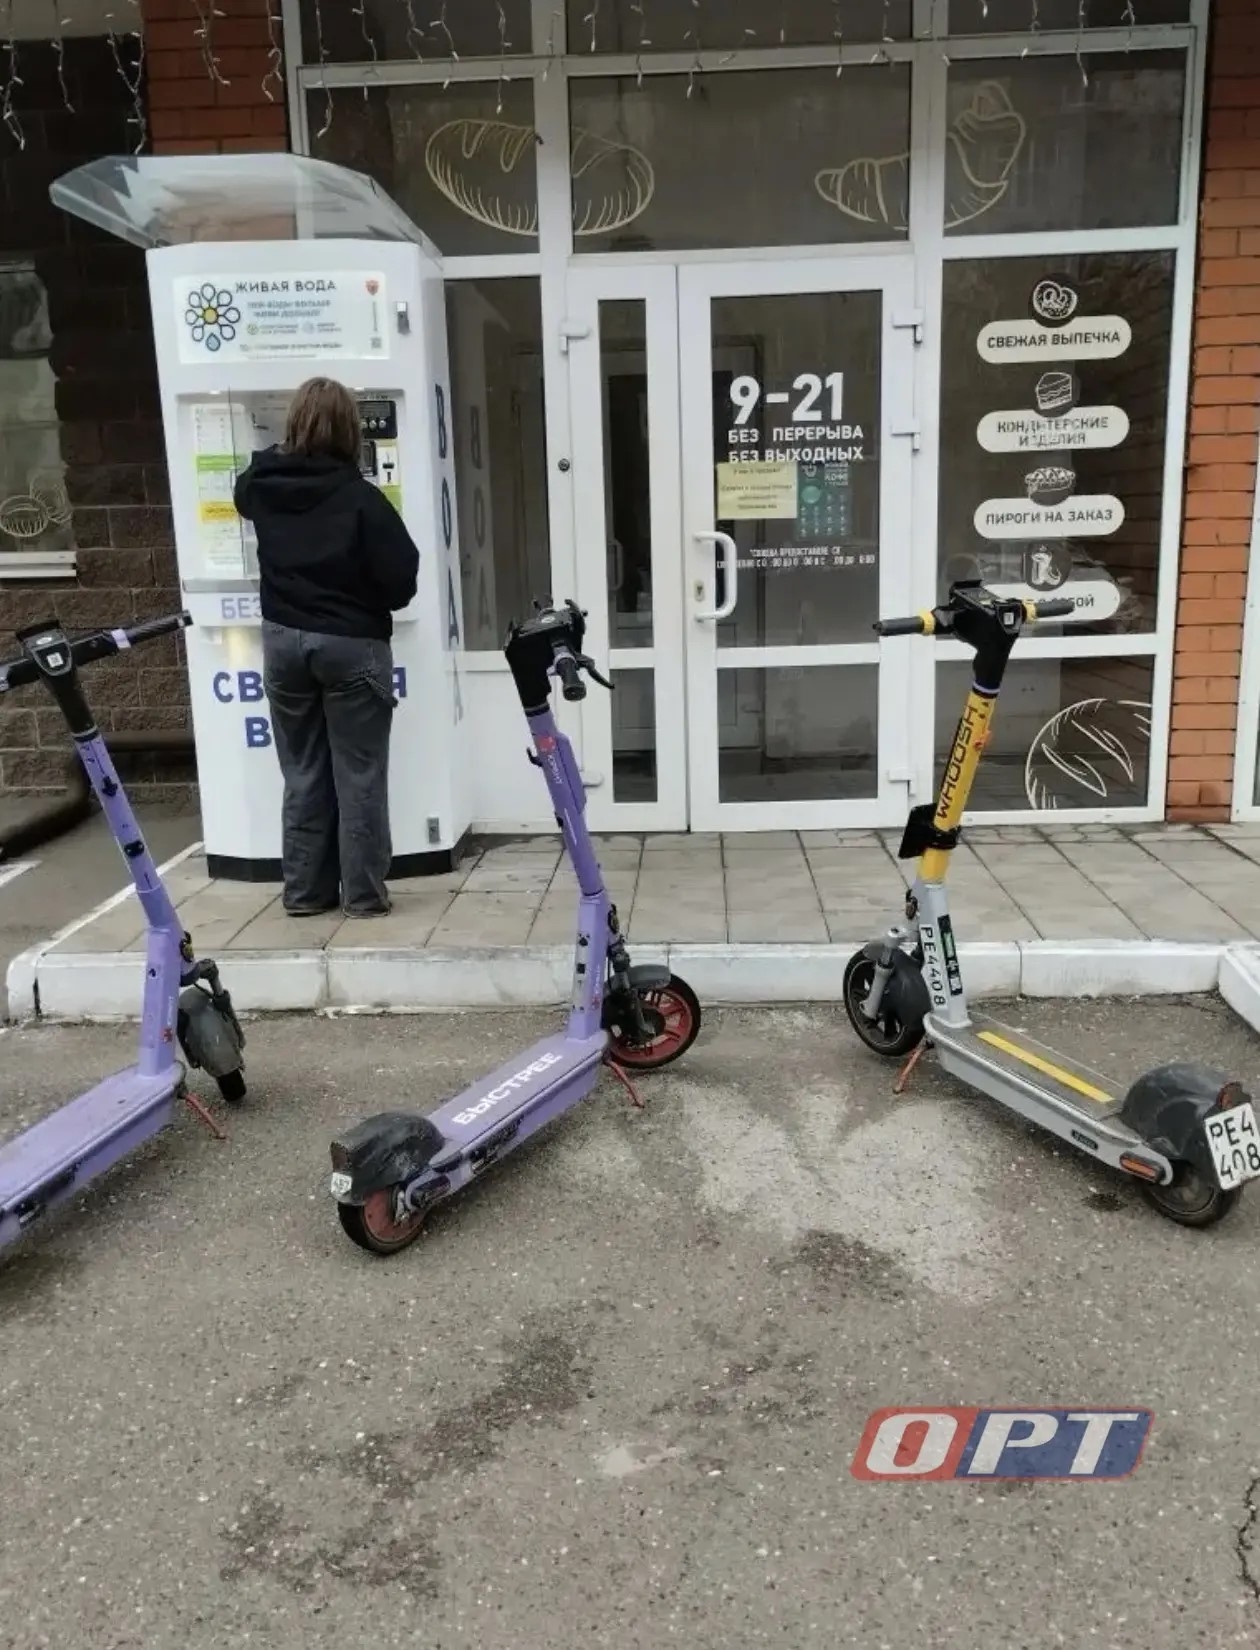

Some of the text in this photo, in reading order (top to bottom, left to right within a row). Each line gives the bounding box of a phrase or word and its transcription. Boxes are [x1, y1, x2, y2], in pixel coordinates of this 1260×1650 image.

[235, 279, 337, 293] ЖИВАЯ ВОДА
[987, 332, 1121, 349] СВЕЖАЯ ВЫПЕЧКА
[729, 371, 844, 425] 9-21
[728, 425, 864, 443] БЕЗ ПЕРЕРЫВА
[728, 446, 864, 464] БЕЗ ВЫХОДНЫХ
[985, 509, 1113, 526] ПИРОГИ НА ЗАКАЗ
[936, 705, 979, 819] WHOOSH
[452, 1051, 563, 1126] БЫСТРЕЕ
